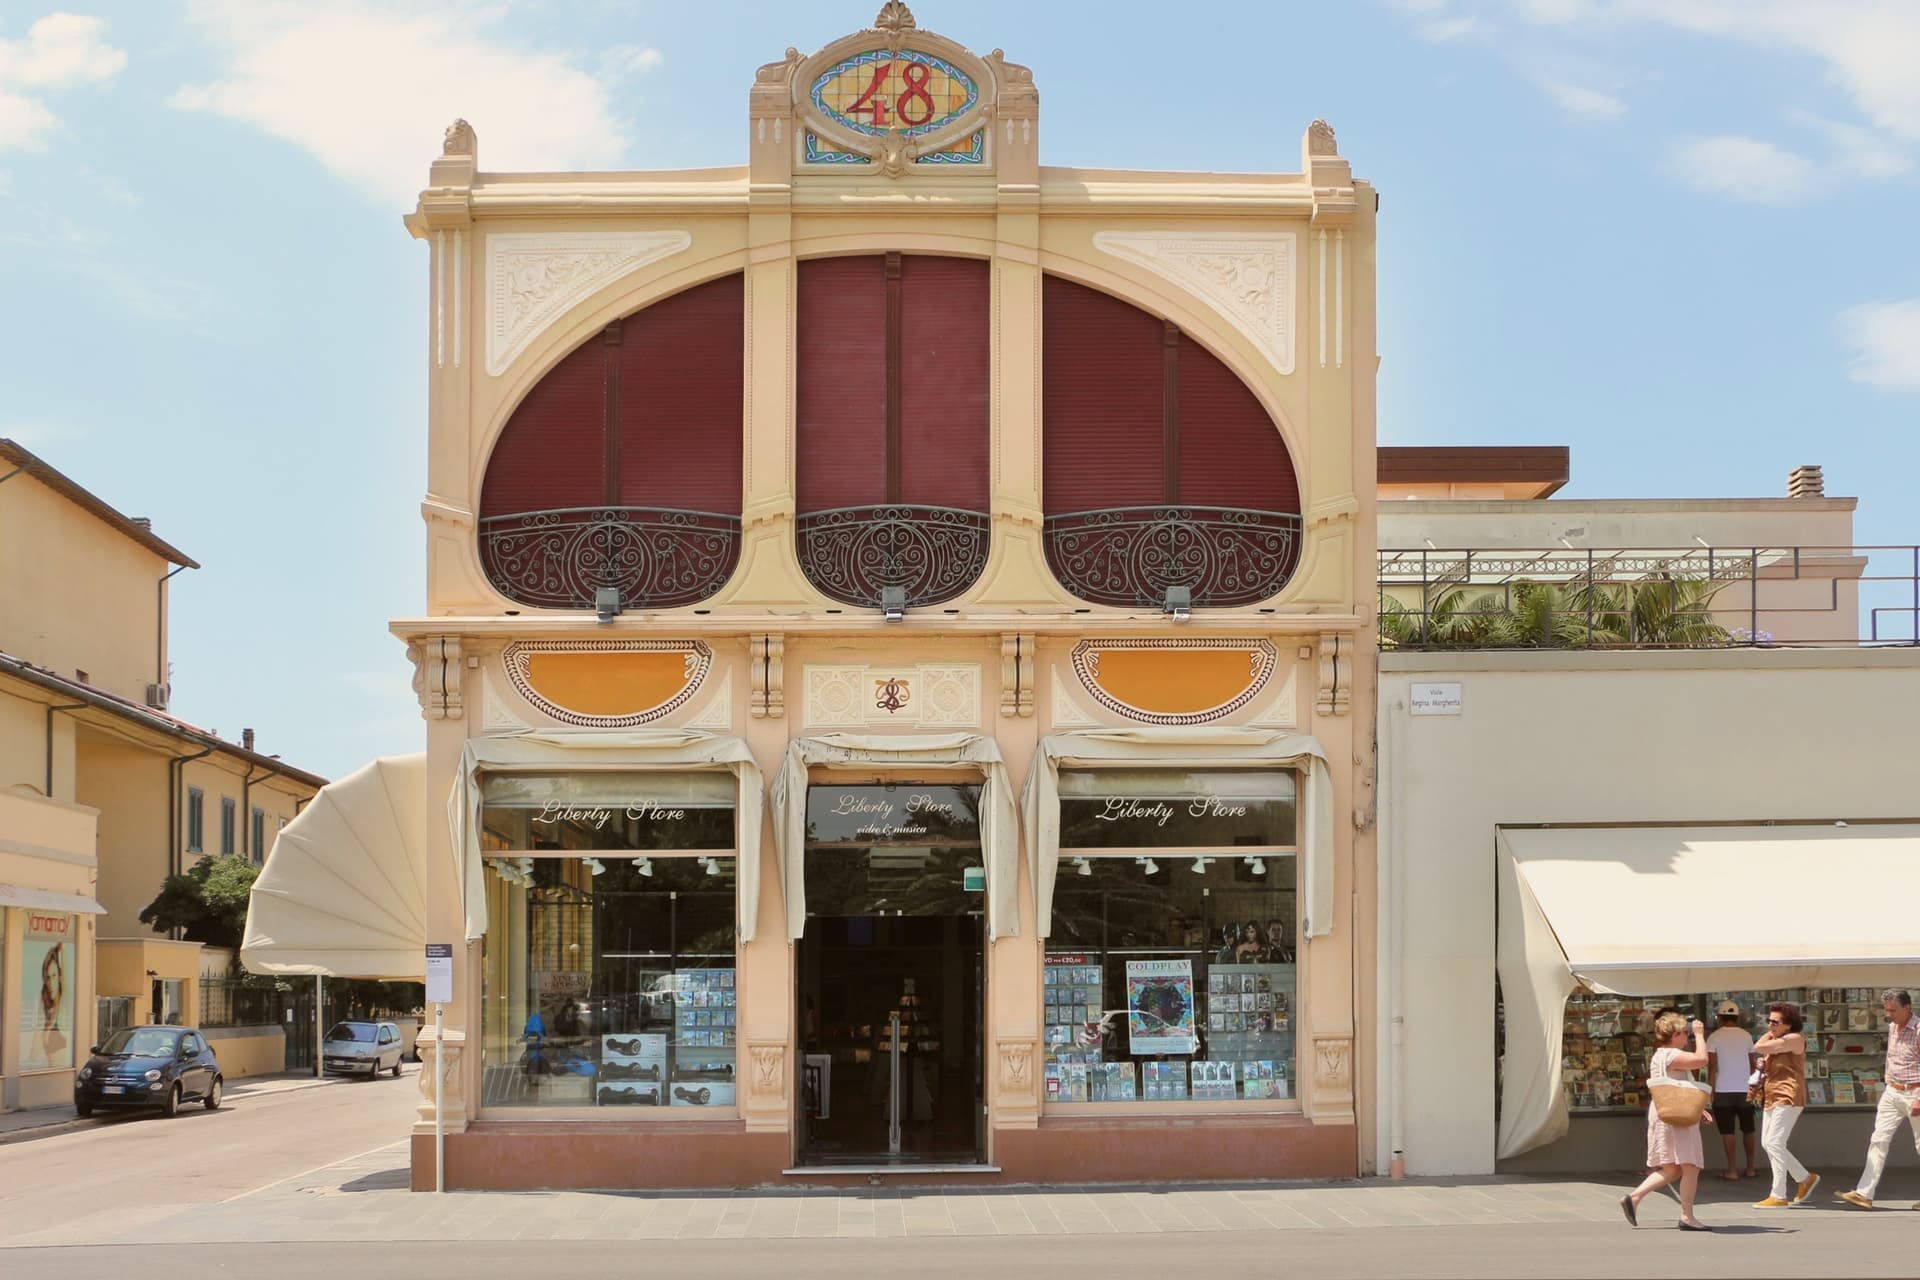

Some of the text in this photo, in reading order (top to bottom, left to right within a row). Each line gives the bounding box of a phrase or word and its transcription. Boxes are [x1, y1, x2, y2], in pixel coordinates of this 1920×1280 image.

[846, 62, 936, 126] 48
[532, 799, 685, 830] Liberty Store
[830, 794, 953, 819] Liberty Store
[1095, 795, 1247, 827] Liberty Store
[856, 823, 928, 836] video & musica
[1128, 961, 1190, 971] COLDPLAY
